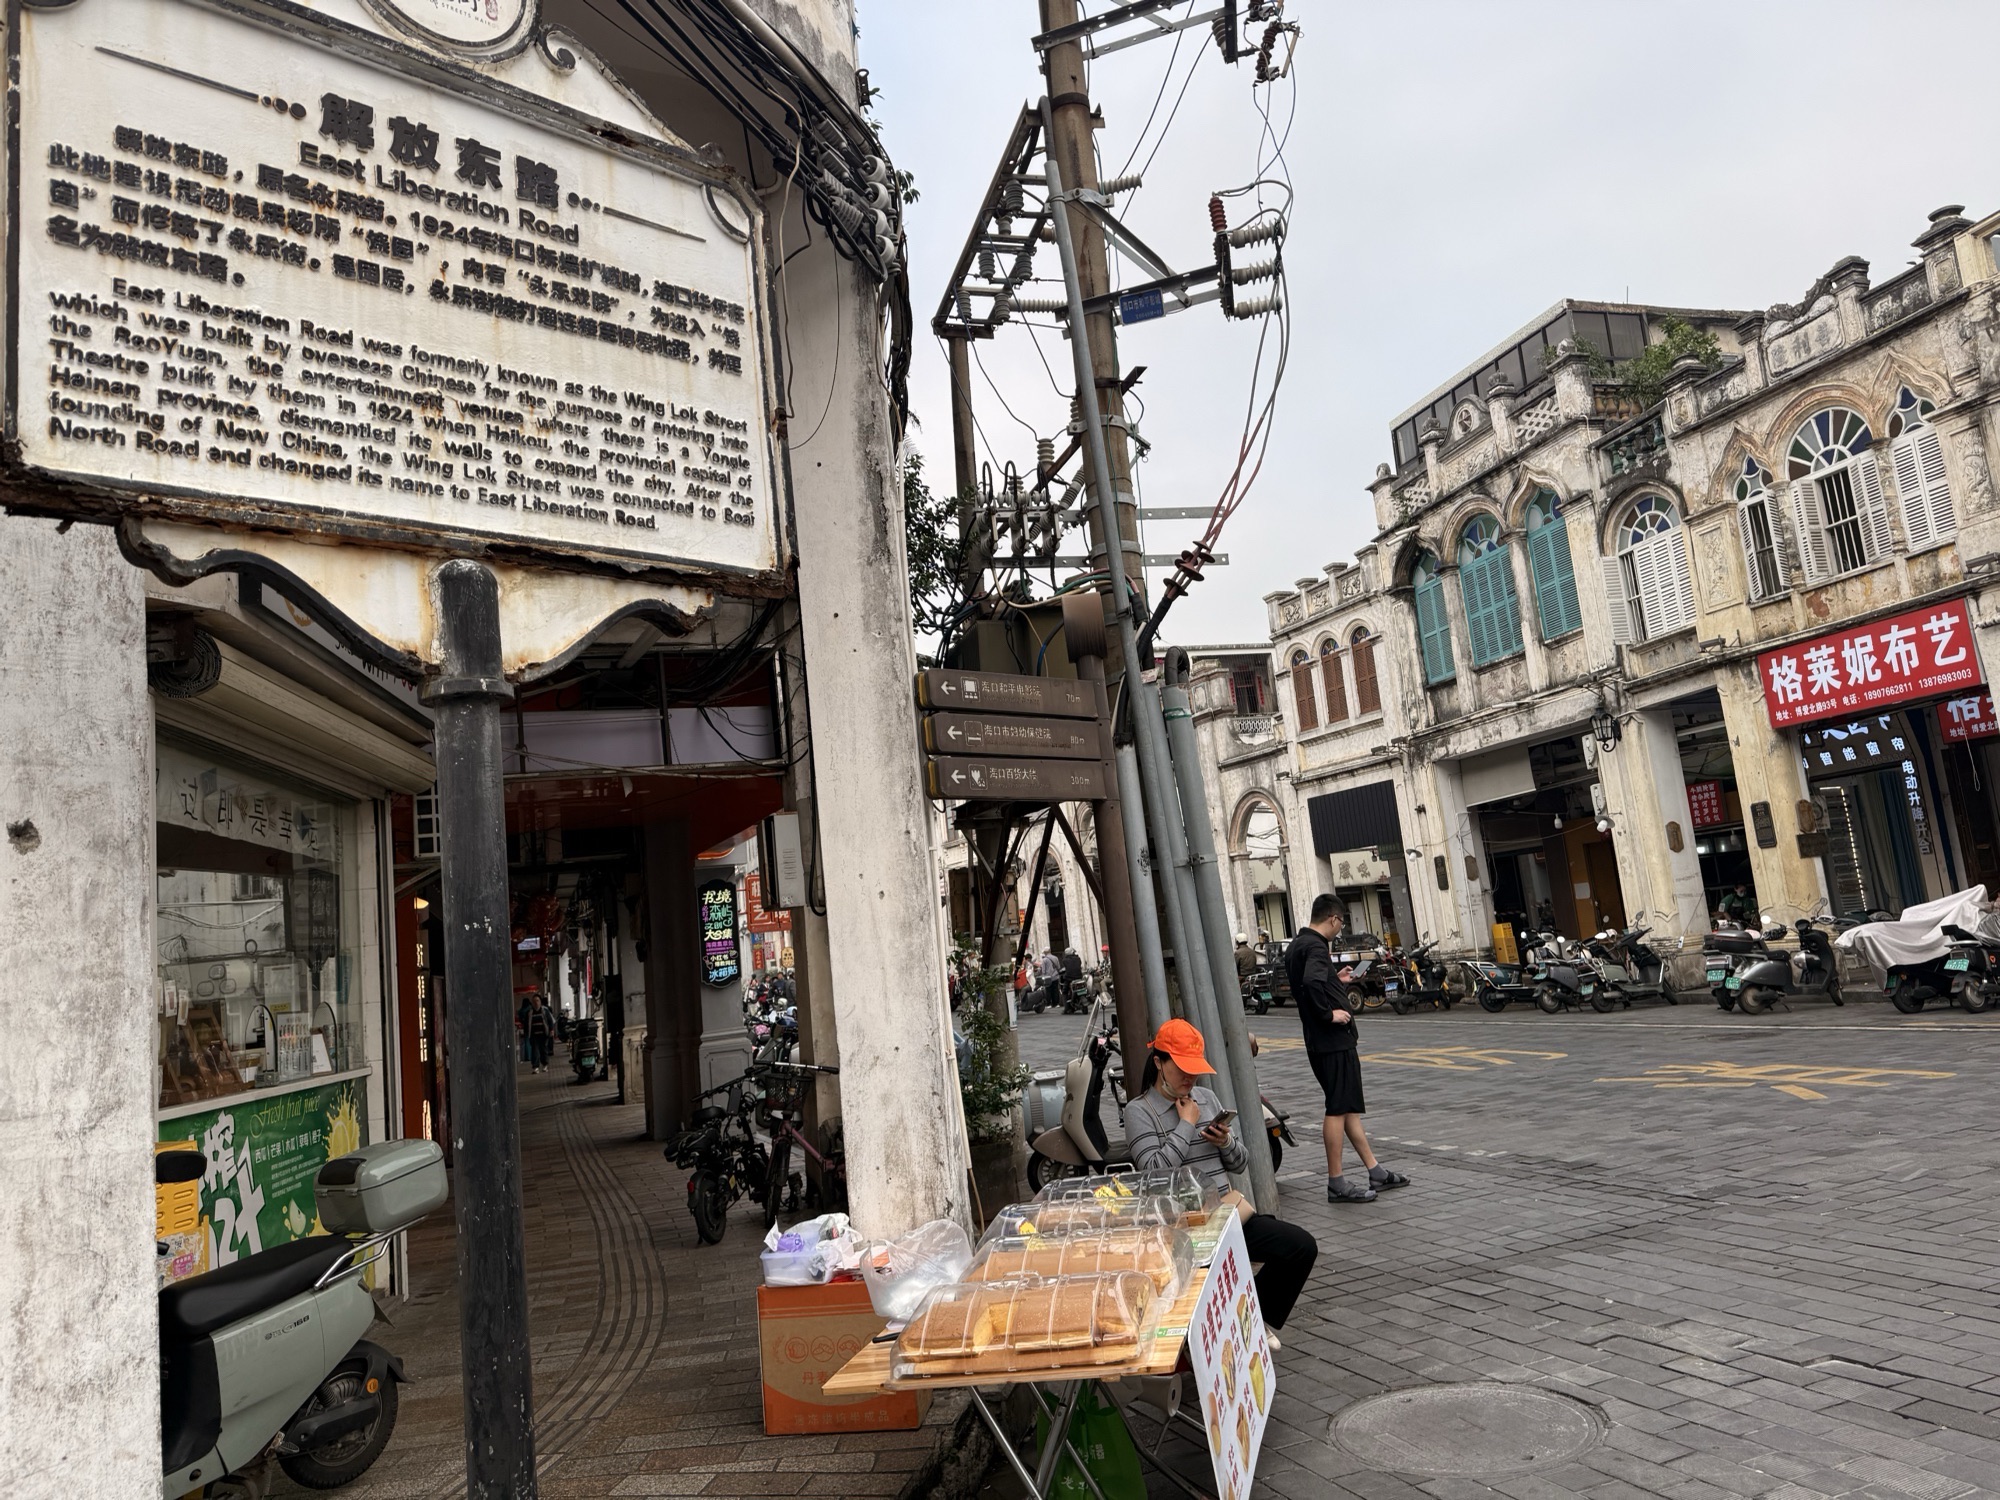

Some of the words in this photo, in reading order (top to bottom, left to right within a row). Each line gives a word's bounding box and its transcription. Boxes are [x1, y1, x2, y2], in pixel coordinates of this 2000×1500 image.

[441, 2, 472, 19] STREETS
[298, 140, 366, 183] East
[375, 164, 510, 225] Liberation
[517, 207, 579, 245] Road
[319, 92, 560, 212] 解放东路
[46, 214, 246, 286] 名为解放东路。
[49, 291, 128, 321] which
[140, 312, 190, 335] was
[201, 320, 254, 348] built
[263, 334, 291, 361] by
[301, 345, 393, 377] overseas
[402, 365, 476, 395] Chinese
[484, 381, 510, 400] for
[517, 390, 547, 409] the
[555, 400, 623, 424] purpose
[630, 415, 646, 430] of
[652, 421, 715, 447] entering
[721, 431, 749, 450] into
[49, 314, 92, 338] the
[245, 355, 284, 378] the
[301, 369, 445, 413] entertainment
[454, 400, 524, 428] venues
[538, 415, 589, 438] where
[602, 427, 645, 448] there
[656, 436, 669, 453] is
[680, 445, 691, 458] a
[701, 446, 750, 470] Yongle
[112, 277, 166, 305] East
[176, 291, 290, 332] Liberation
[300, 318, 354, 346] Road
[361, 337, 403, 357] was
[410, 344, 490, 379] formerly
[497, 363, 558, 391] known
[564, 382, 584, 397] as
[588, 384, 618, 404] the
[623, 391, 665, 417] Wing
[670, 402, 699, 422] Lok
[704, 410, 748, 433] Street
[49, 338, 149, 375] Theatre
[162, 361, 214, 387] built
[228, 374, 257, 395] by
[266, 382, 326, 408] them
[337, 394, 356, 414] in
[368, 400, 414, 425] 1924
[421, 408, 476, 437] when
[560, 439, 590, 458] the
[599, 448, 676, 474] provincial
[682, 465, 732, 485] capital
[737, 474, 752, 489] of
[49, 391, 165, 434] founding
[180, 416, 203, 433] of
[215, 418, 269, 445] New
[359, 445, 393, 465] the
[403, 452, 454, 479] Wing
[463, 462, 497, 484] Lok
[506, 470, 561, 493] Street
[570, 485, 604, 501] was
[612, 492, 694, 515] connected
[700, 504, 716, 519] to
[723, 507, 755, 526] Boai
[50, 364, 141, 401] Hainan
[279, 407, 396, 444] dismantled
[408, 430, 432, 451] its
[443, 440, 493, 461] walls
[503, 450, 523, 466] to
[534, 458, 597, 481] expand
[605, 468, 634, 486] the
[686, 482, 722, 500] After
[729, 491, 754, 507] the
[49, 416, 126, 446] North
[135, 430, 200, 458] Road
[208, 446, 252, 466] and
[258, 452, 352, 481] changed
[357, 465, 383, 485] its
[390, 476, 444, 496] name
[449, 484, 470, 500] to
[478, 486, 517, 508] East
[521, 494, 609, 522] Liberation
[981, 680, 1042, 696] 海口和平电影院
[1066, 693, 1081, 703] 70m
[1768, 611, 1967, 705] 格莱妮布艺
[1918, 668, 1972, 689] 13876983003
[984, 723, 1052, 740] 海口市妇幼保健院
[1070, 735, 1085, 745] 80m
[989, 767, 1038, 781] 海口百货大楼
[1901, 760, 1931, 854] 电动升降开合
[704, 929, 733, 942] 大合集
[709, 966, 738, 983] 冰箱贴
[250, 1096, 284, 1138] Fresh
[283, 1095, 303, 1131] fruit
[298, 1092, 321, 1126] juice
